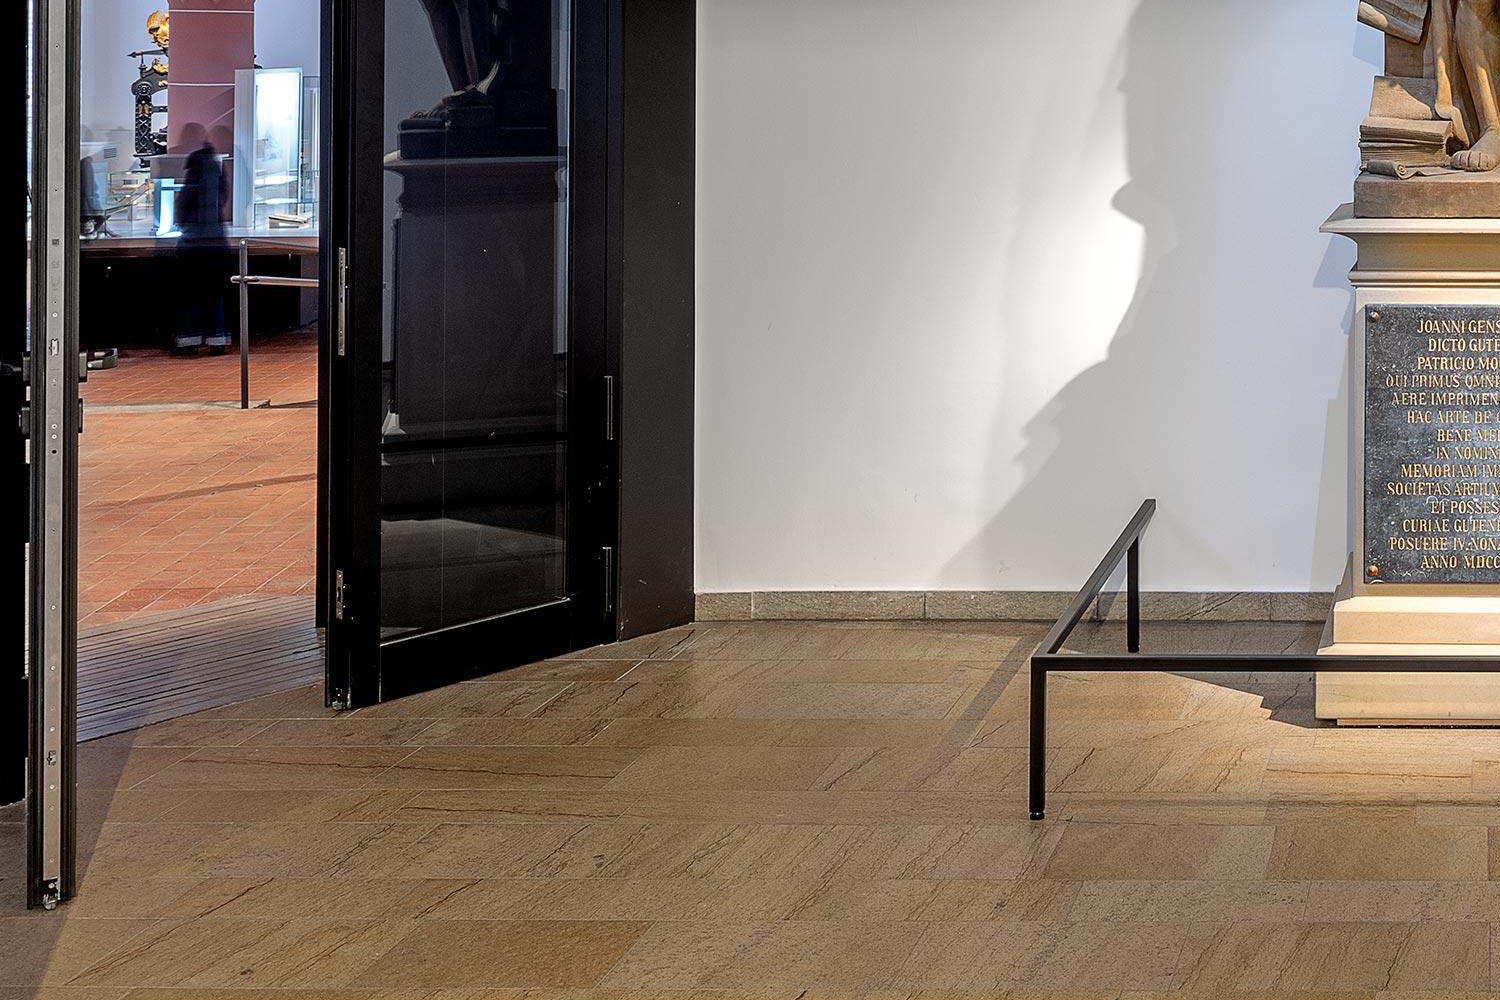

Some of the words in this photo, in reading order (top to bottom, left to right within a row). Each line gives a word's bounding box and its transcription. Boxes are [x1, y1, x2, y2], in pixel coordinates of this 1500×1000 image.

[1417, 319, 1464, 334] JOANNI
[1428, 338, 1465, 352] DICTO
[1417, 356, 1474, 371] PATRICIO
[1386, 374, 1407, 389] QUI
[1411, 374, 1460, 389] PRIMUS
[1392, 392, 1426, 407] AERE
[1407, 410, 1431, 424] HAC
[1436, 410, 1469, 424] ARTE
[1474, 410, 1491, 424] DE
[1437, 429, 1472, 442] BENE
[1436, 446, 1449, 460] IN
[1401, 464, 1479, 478] MEMORIAM
[1387, 482, 1450, 496] SOCIETAS
[1431, 500, 1448, 515] ET
[1403, 519, 1449, 533] CURIAE
[1390, 537, 1447, 551] POSUERE
[1421, 555, 1458, 569] ANNO
